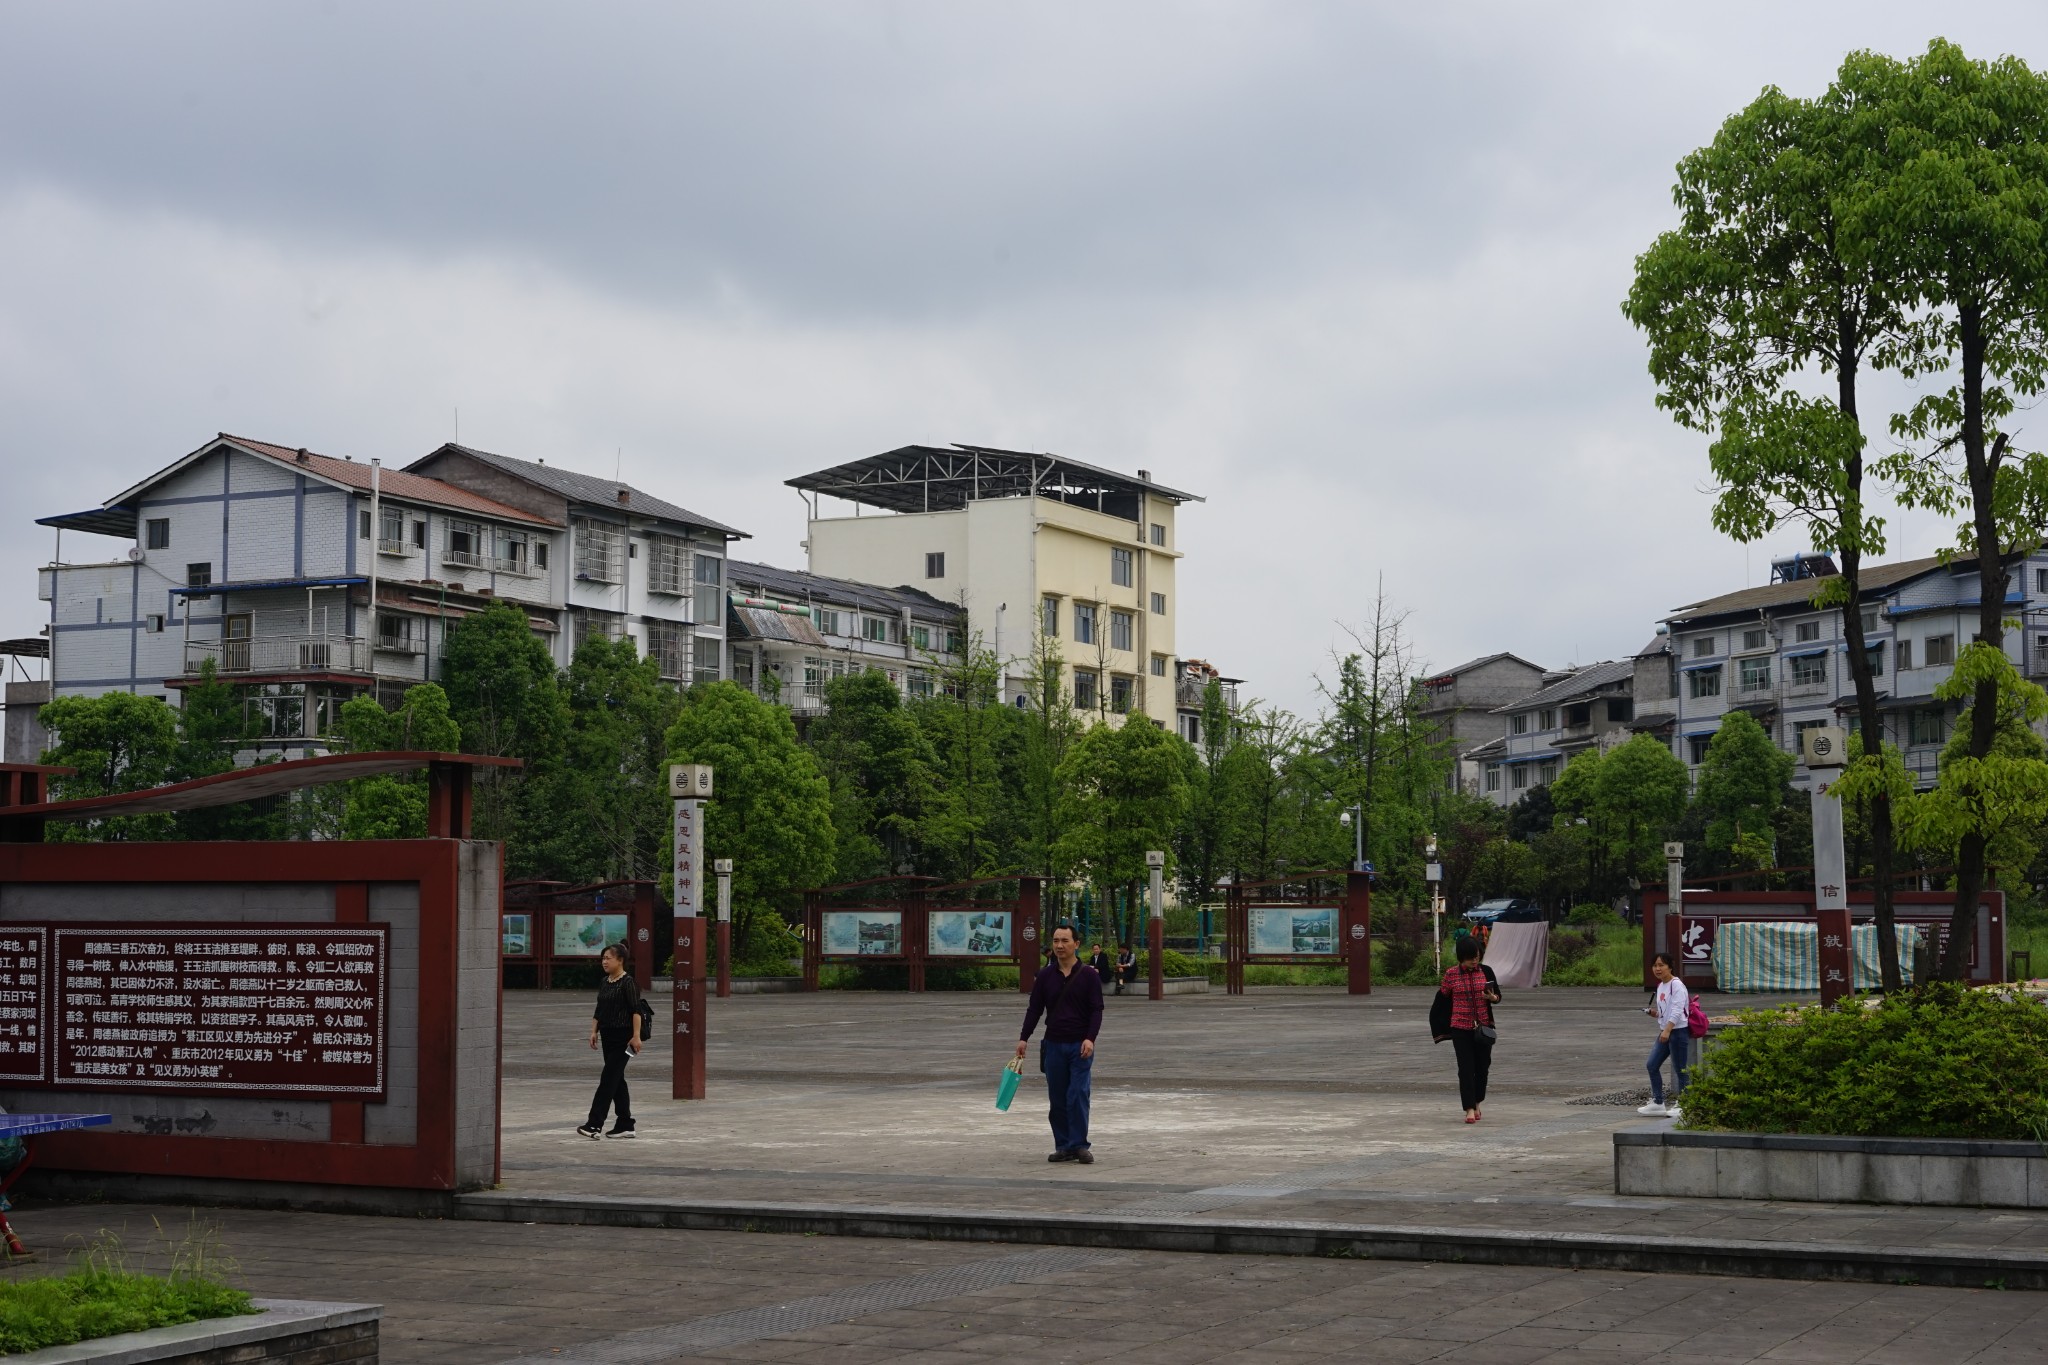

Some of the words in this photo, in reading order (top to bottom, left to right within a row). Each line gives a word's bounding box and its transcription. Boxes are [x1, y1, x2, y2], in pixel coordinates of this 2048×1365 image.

[677, 808, 691, 906] 感恩是精神上
[1820, 884, 1840, 898] 信
[676, 935, 691, 1034] 的一种宝藏
[1823, 934, 1845, 982] 就是
